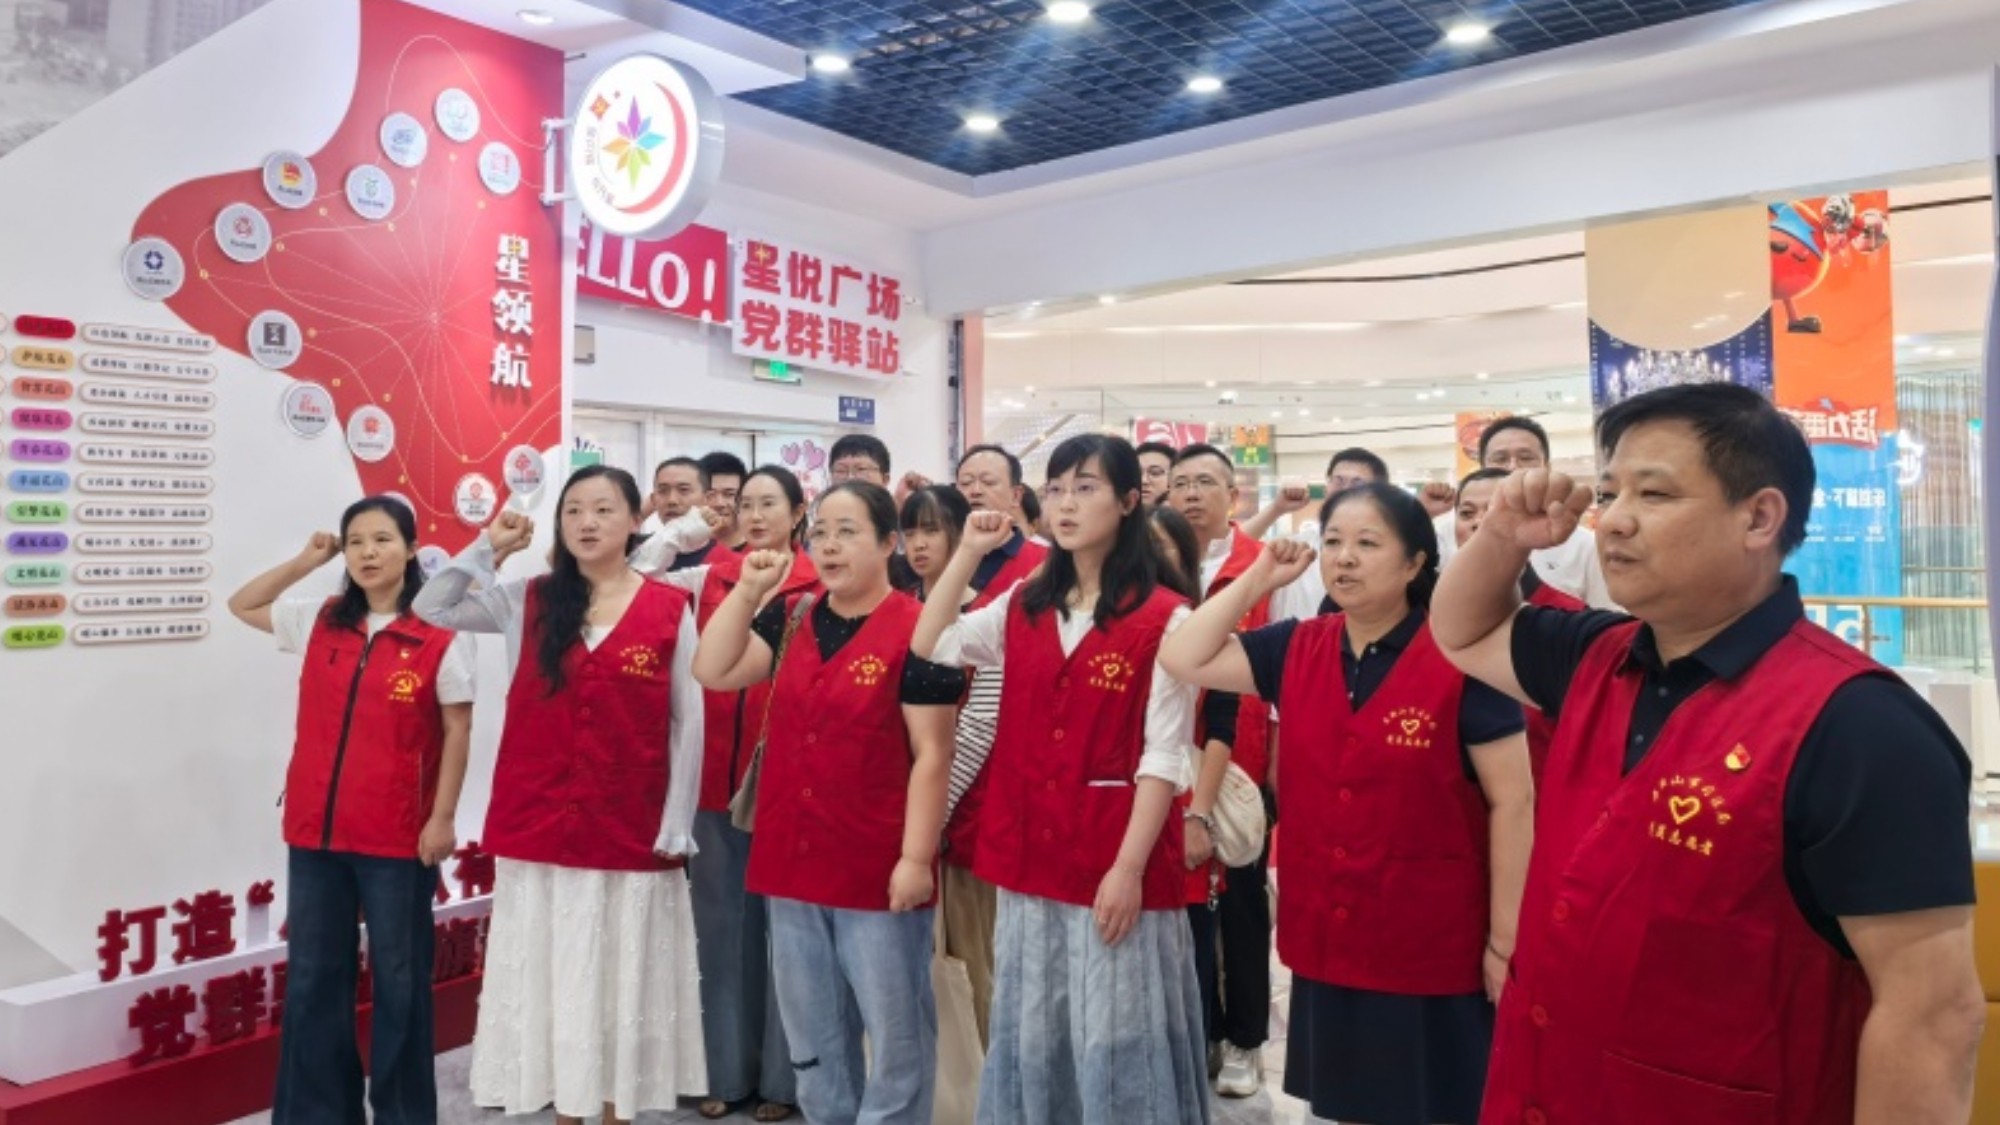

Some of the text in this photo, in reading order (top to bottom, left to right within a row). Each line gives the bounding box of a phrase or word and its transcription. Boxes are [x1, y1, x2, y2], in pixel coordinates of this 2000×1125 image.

[490, 233, 534, 389] 星领航
[742, 239, 900, 321] 星悦广场
[740, 299, 899, 374] 党群驿站
